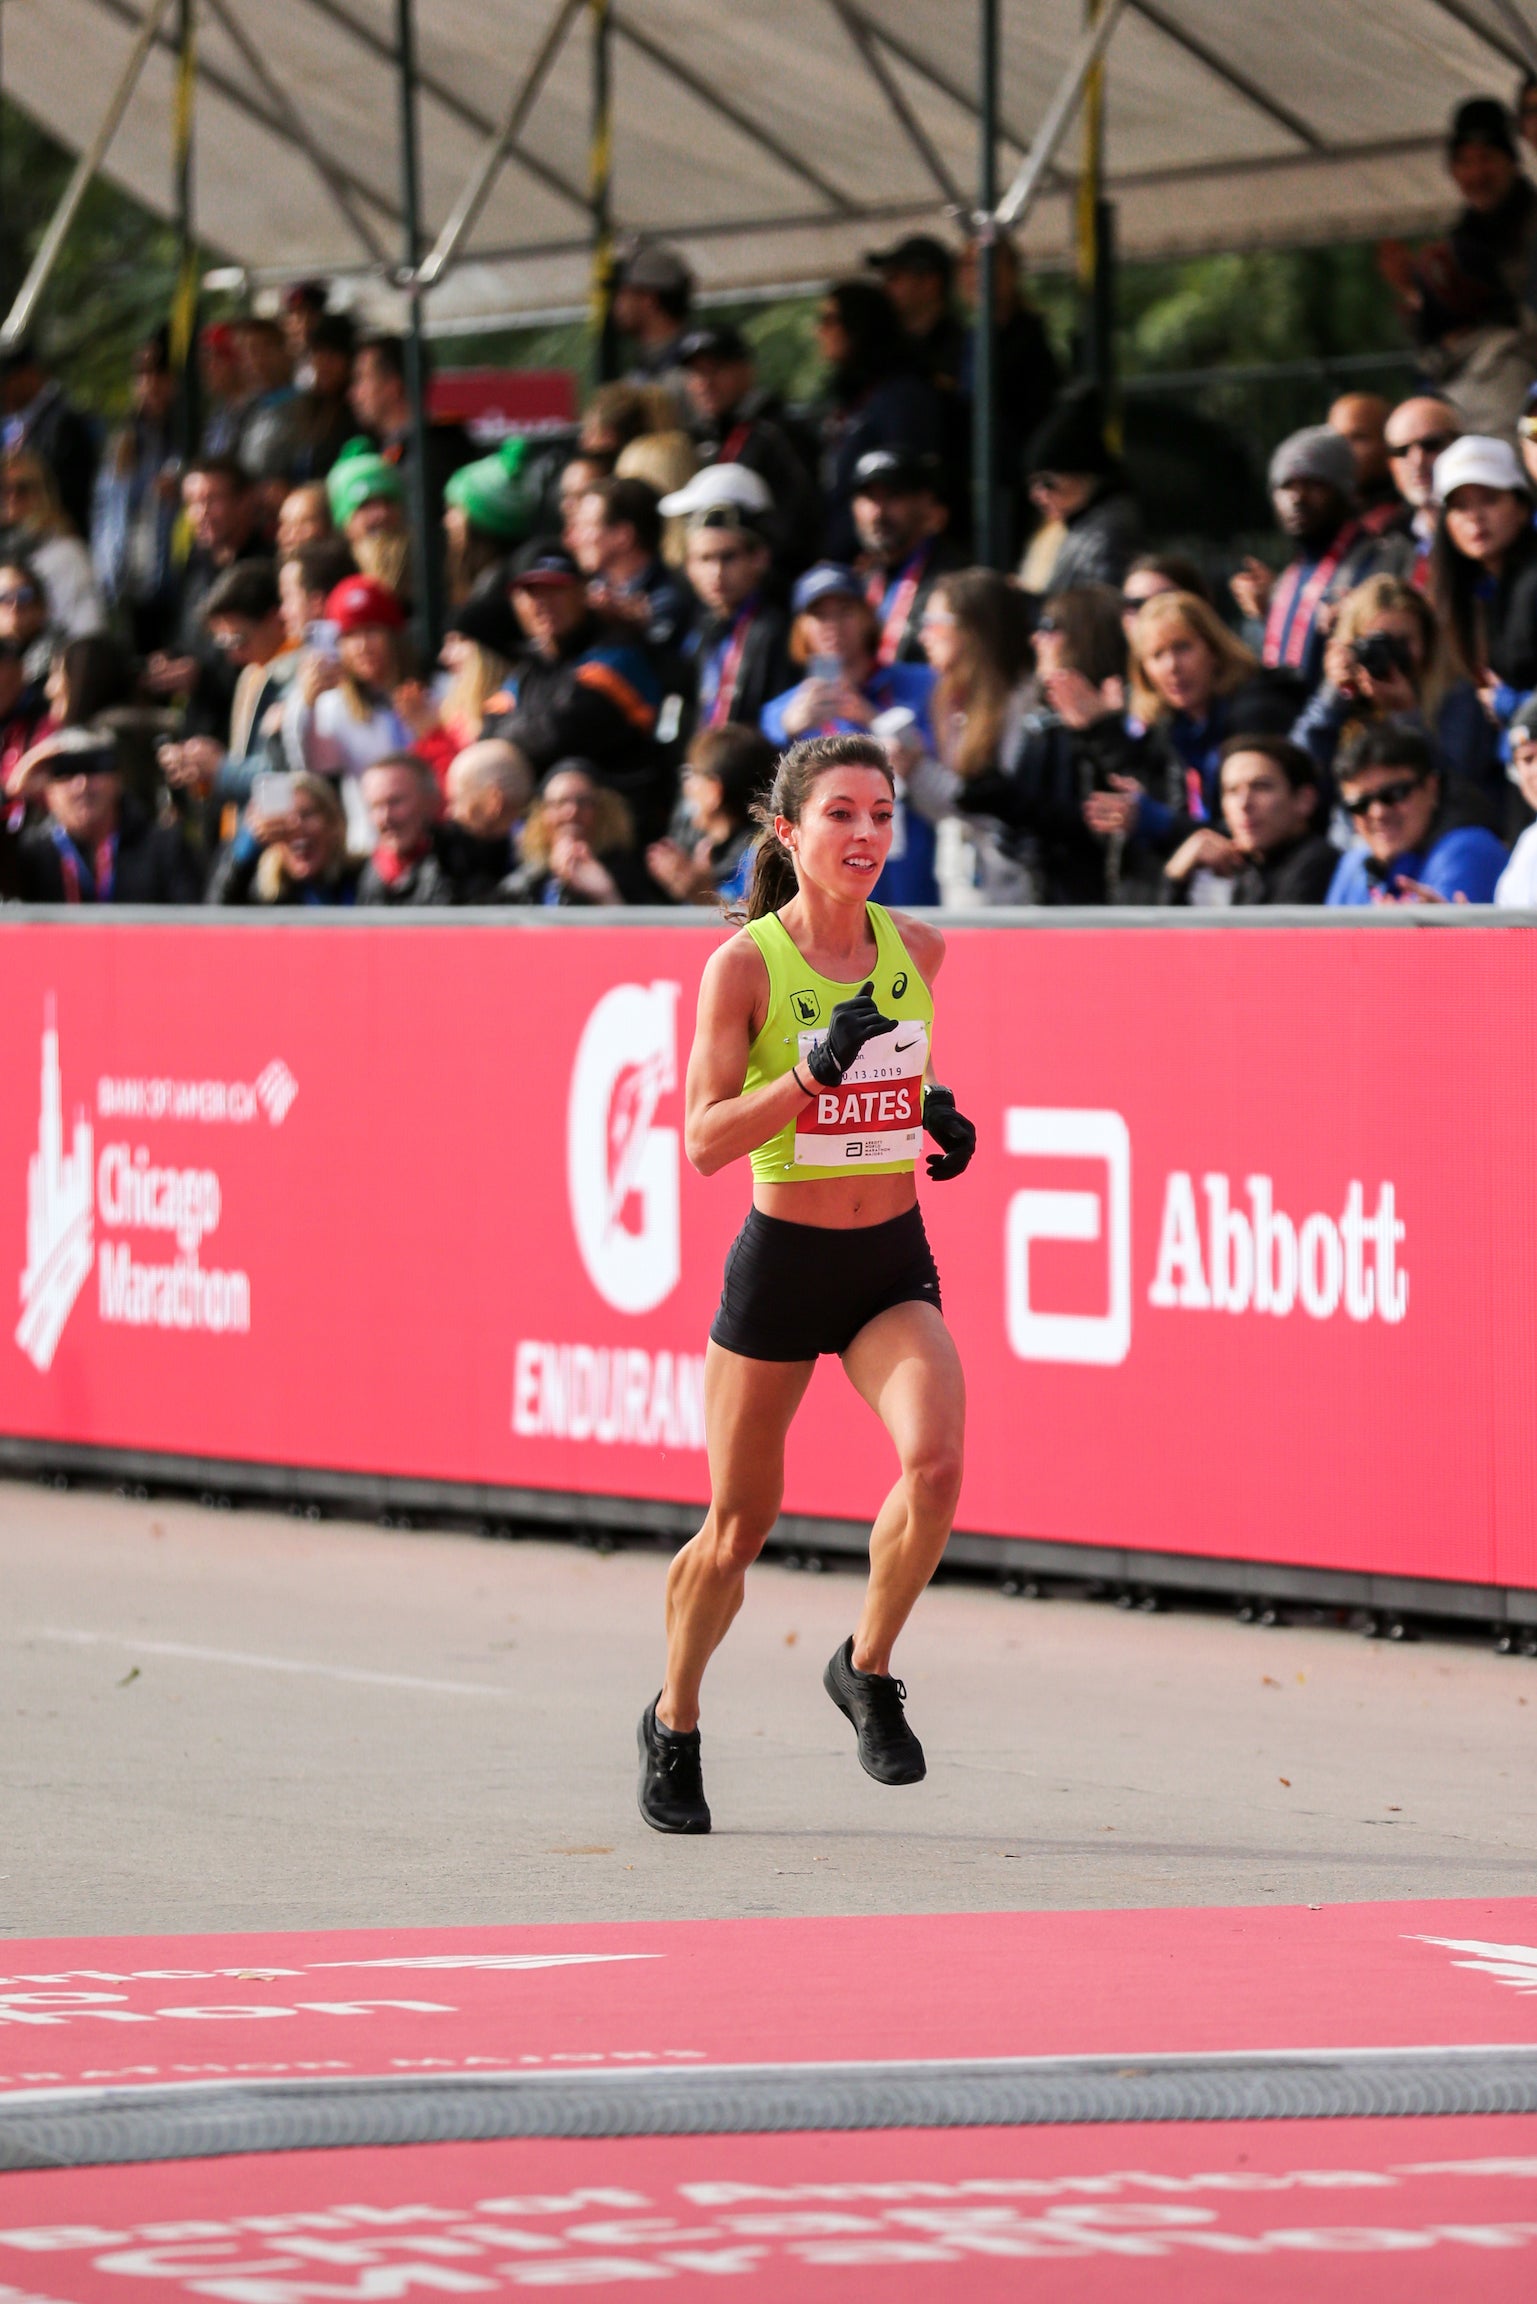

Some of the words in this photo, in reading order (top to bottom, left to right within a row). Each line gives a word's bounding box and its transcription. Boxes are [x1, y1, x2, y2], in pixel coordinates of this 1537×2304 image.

[817, 1088, 911, 1124] BATES
[100, 1142, 221, 1251] Chicago
[1148, 1171, 1409, 1324] Abbott
[100, 1241, 250, 1333] Marathon
[0, 1999, 460, 2024] hon
[676, 2170, 1402, 2206] America
[92, 2202, 1219, 2279] Chicago
